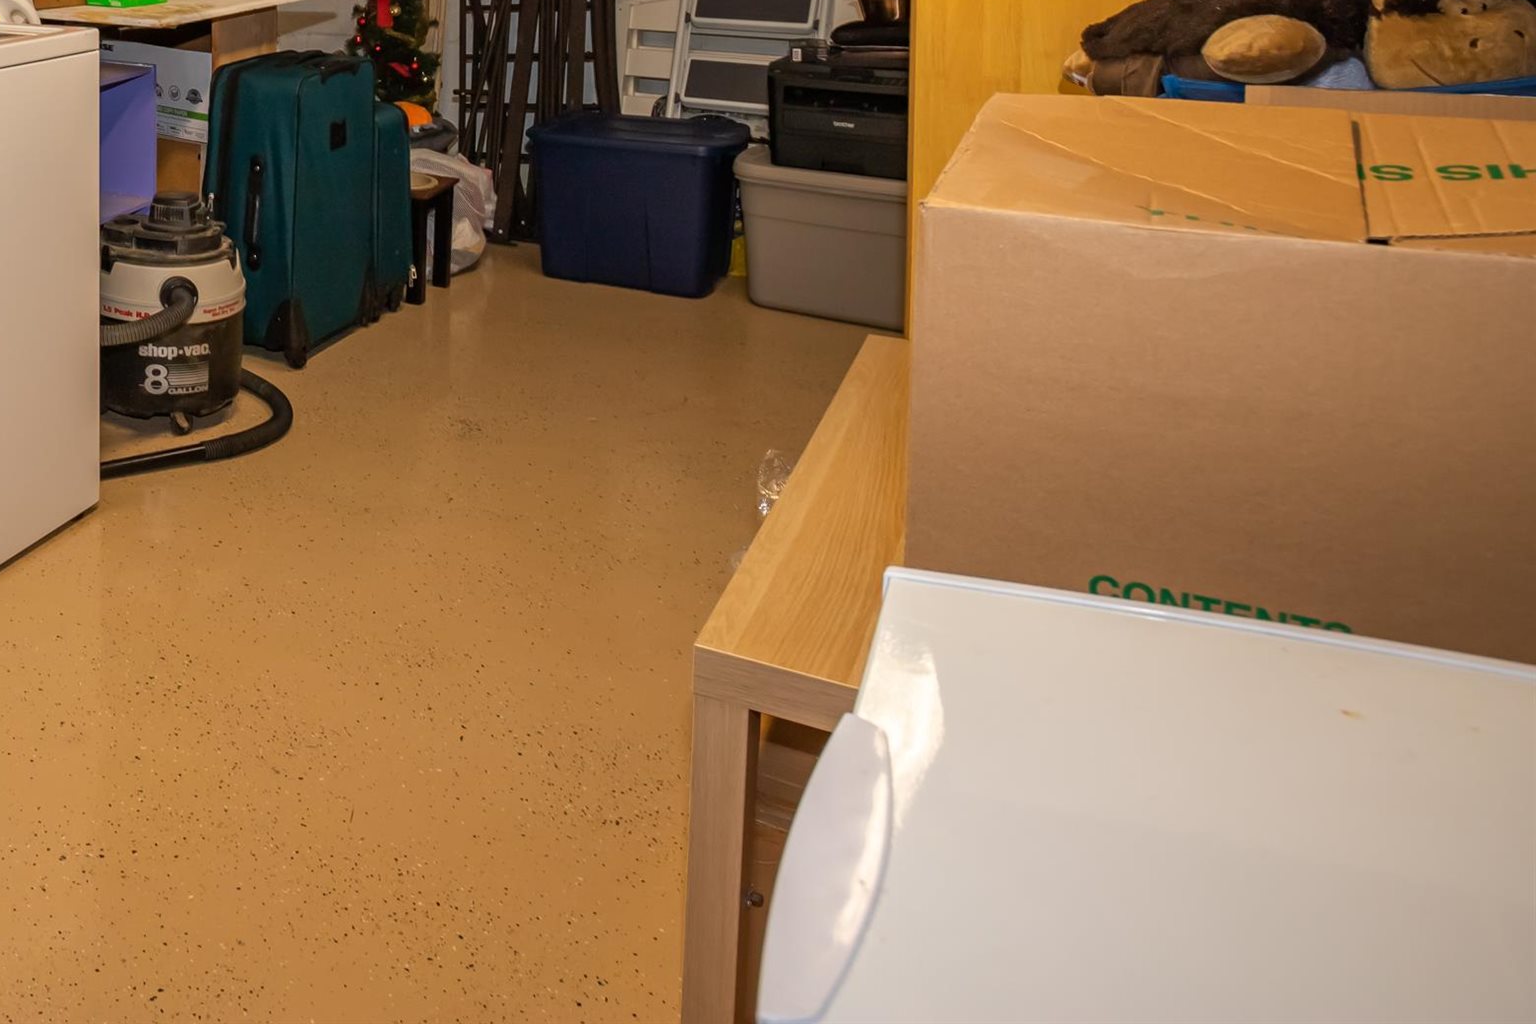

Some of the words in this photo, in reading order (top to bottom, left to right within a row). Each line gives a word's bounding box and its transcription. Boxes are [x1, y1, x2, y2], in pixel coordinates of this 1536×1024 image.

[114, 308, 133, 317] Peak
[144, 364, 169, 395] 8
[168, 384, 209, 395] GALLON
